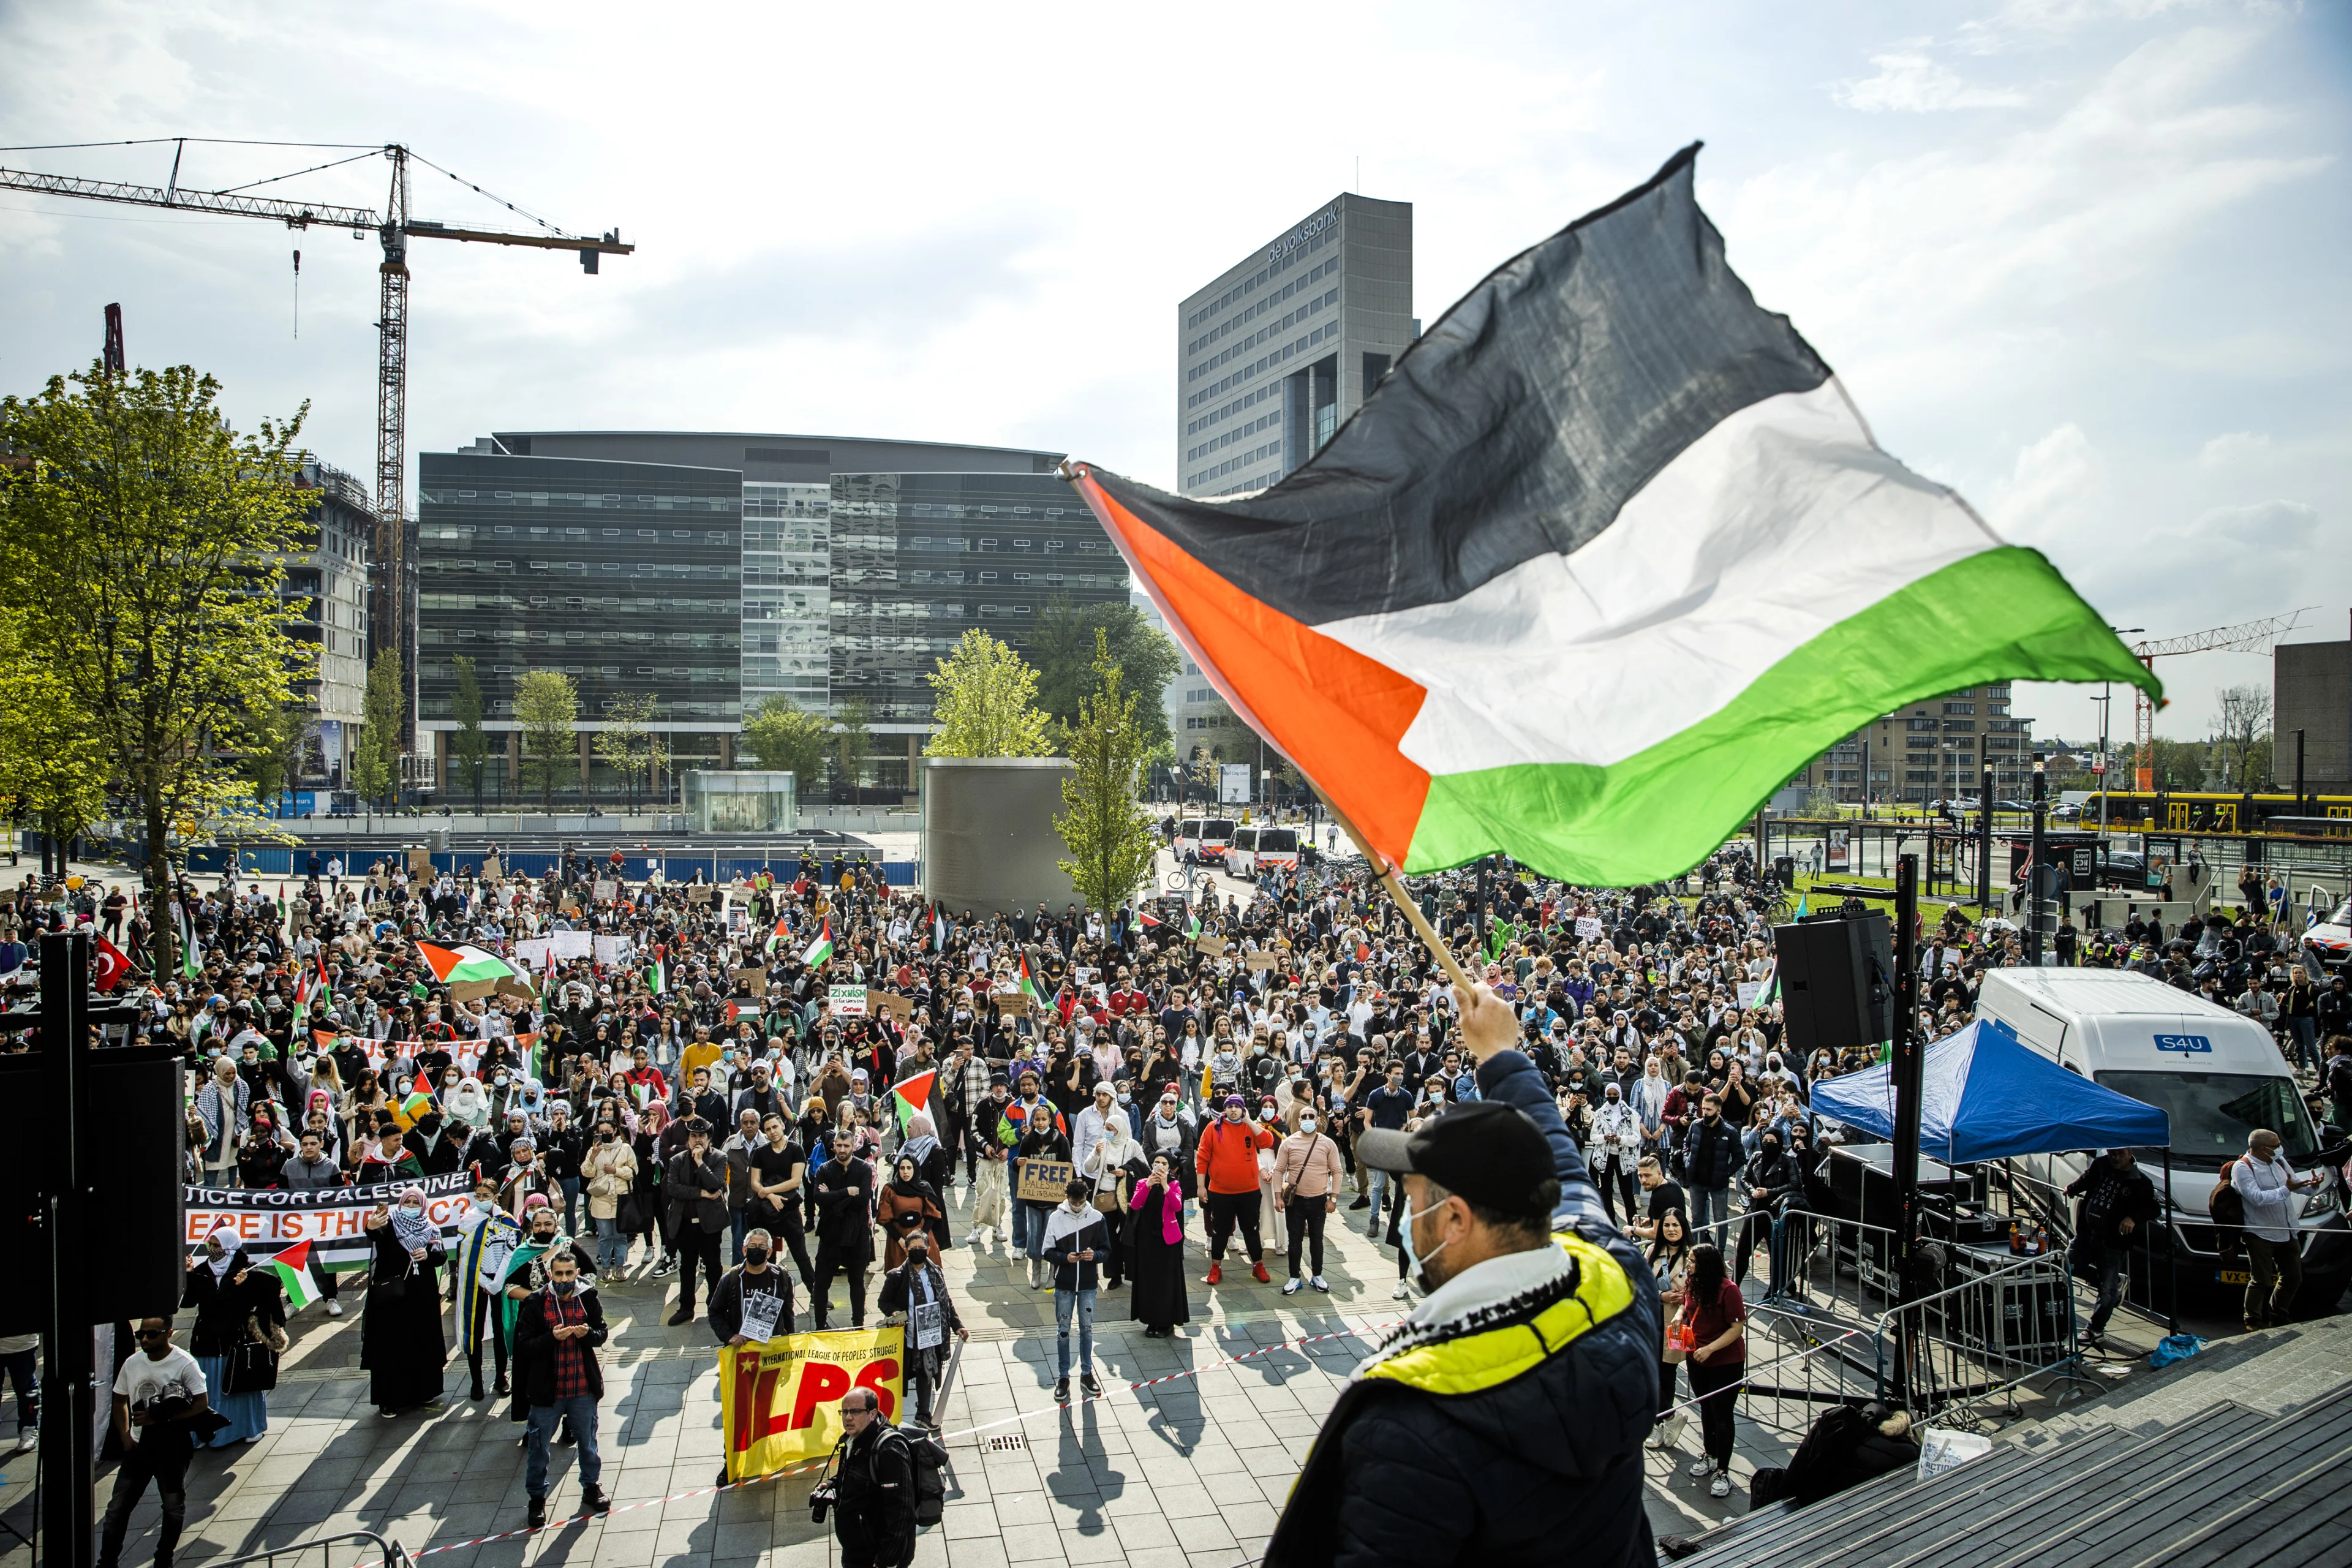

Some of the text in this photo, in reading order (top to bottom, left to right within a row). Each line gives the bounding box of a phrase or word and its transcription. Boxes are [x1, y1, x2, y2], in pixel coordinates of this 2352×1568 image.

[1269, 205, 1338, 262] de volksbank
[2149, 845, 2174, 856] SUSHI
[369, 902, 390, 911] FREE
[1577, 928, 1598, 937] GEWELD
[458, 1041, 484, 1059] FO
[2162, 1038, 2202, 1049] S4U
[1025, 1163, 1069, 1183] FREE
[185, 1170, 471, 1205] TICE FOR PALESTINE!
[1025, 1180, 1066, 1190] PALESTINE
[271, 1213, 304, 1238] IS
[429, 1197, 470, 1225] C?
[762, 1343, 898, 1366] INTERNATIONAL LEAGUE OF PEOPLES' STRUGGLE
[733, 1351, 899, 1452] ILPS
